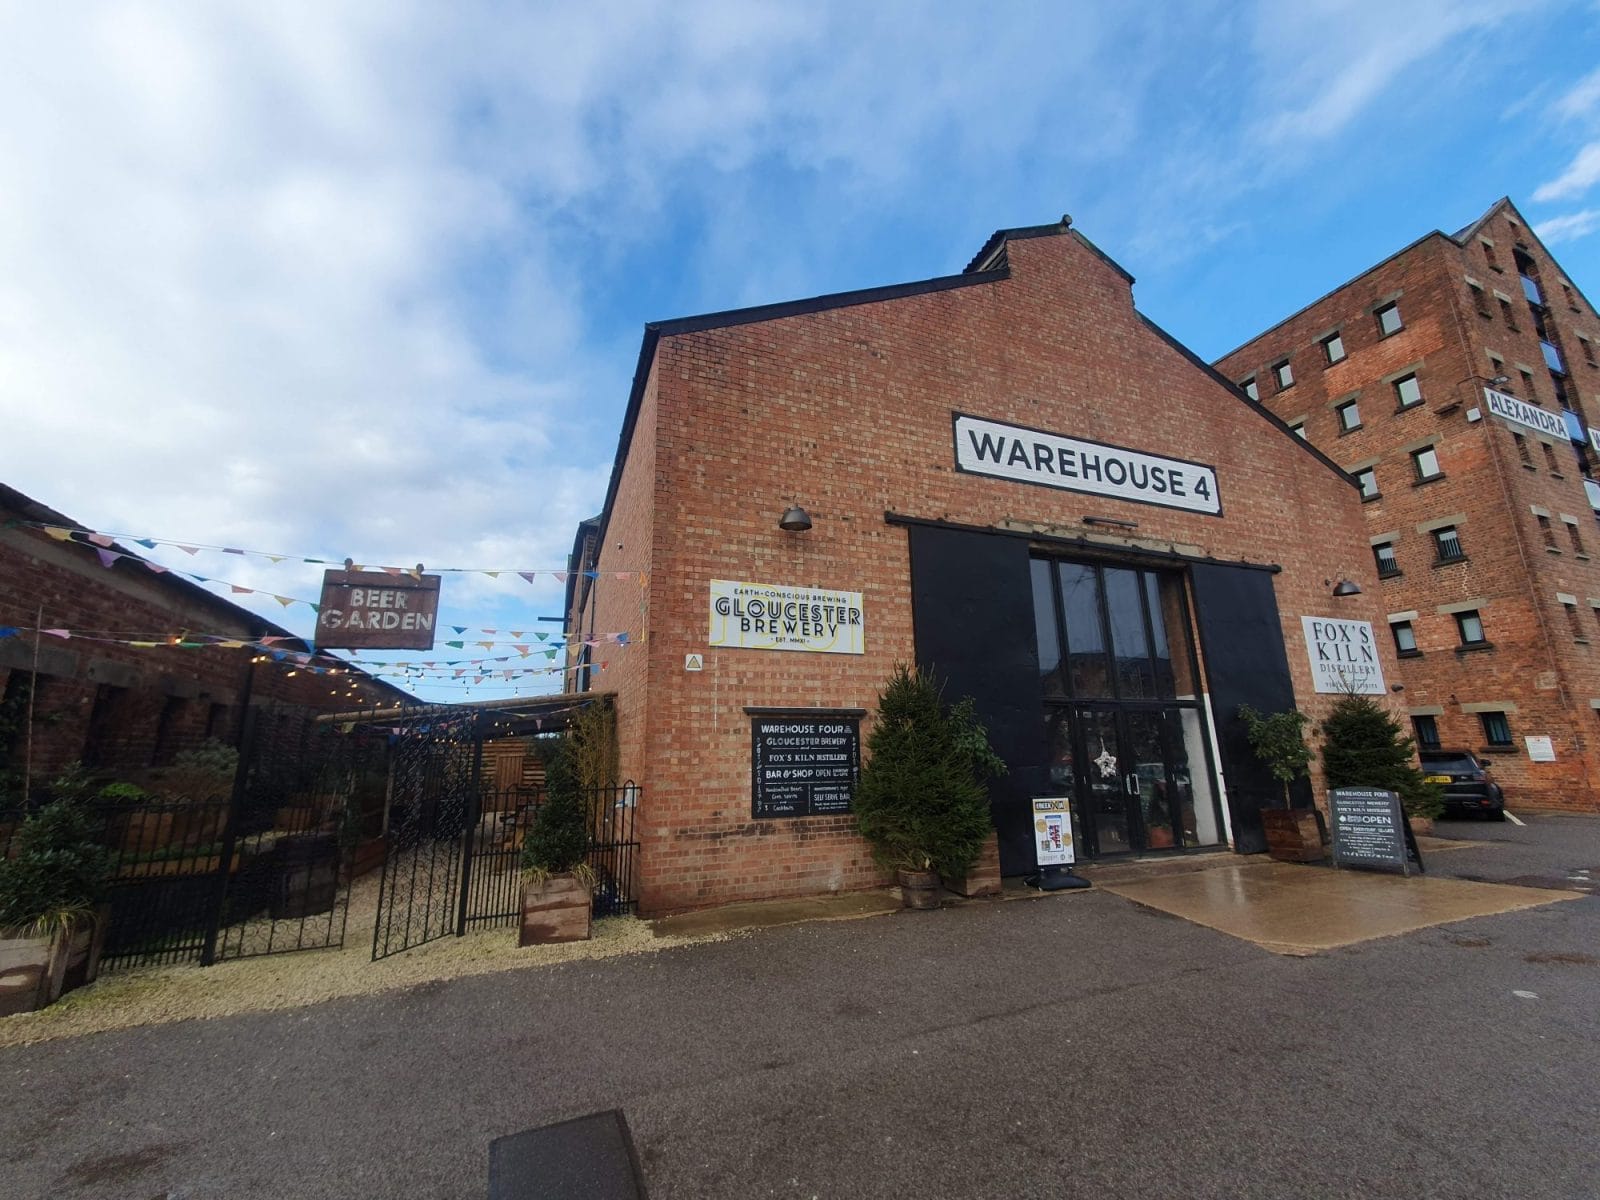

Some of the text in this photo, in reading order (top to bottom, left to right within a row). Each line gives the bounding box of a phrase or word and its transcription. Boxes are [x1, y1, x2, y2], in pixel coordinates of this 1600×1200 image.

[1491, 393, 1566, 437] ALEXANDRA
[968, 430, 1210, 501] WAREHOUSE 4
[350, 589, 408, 609] BEER
[734, 588, 847, 603] EARTH-CONSCIOUS BREWING
[321, 609, 432, 630] GARDEN
[715, 597, 860, 625] GLOUCESTER
[741, 618, 837, 637] BREWERY
[1313, 622, 1369, 643] FOX'S
[1317, 643, 1373, 662] KILN
[1320, 664, 1376, 675] DISTILLERY
[761, 725, 843, 733] WAREHOUSE FOUR
[766, 737, 847, 746] GLOUCESTER BREWERY
[766, 770, 782, 779] BAR
[783, 770, 791, 778] &
[792, 769, 813, 778] SHOP
[1363, 816, 1391, 824] OPEN
